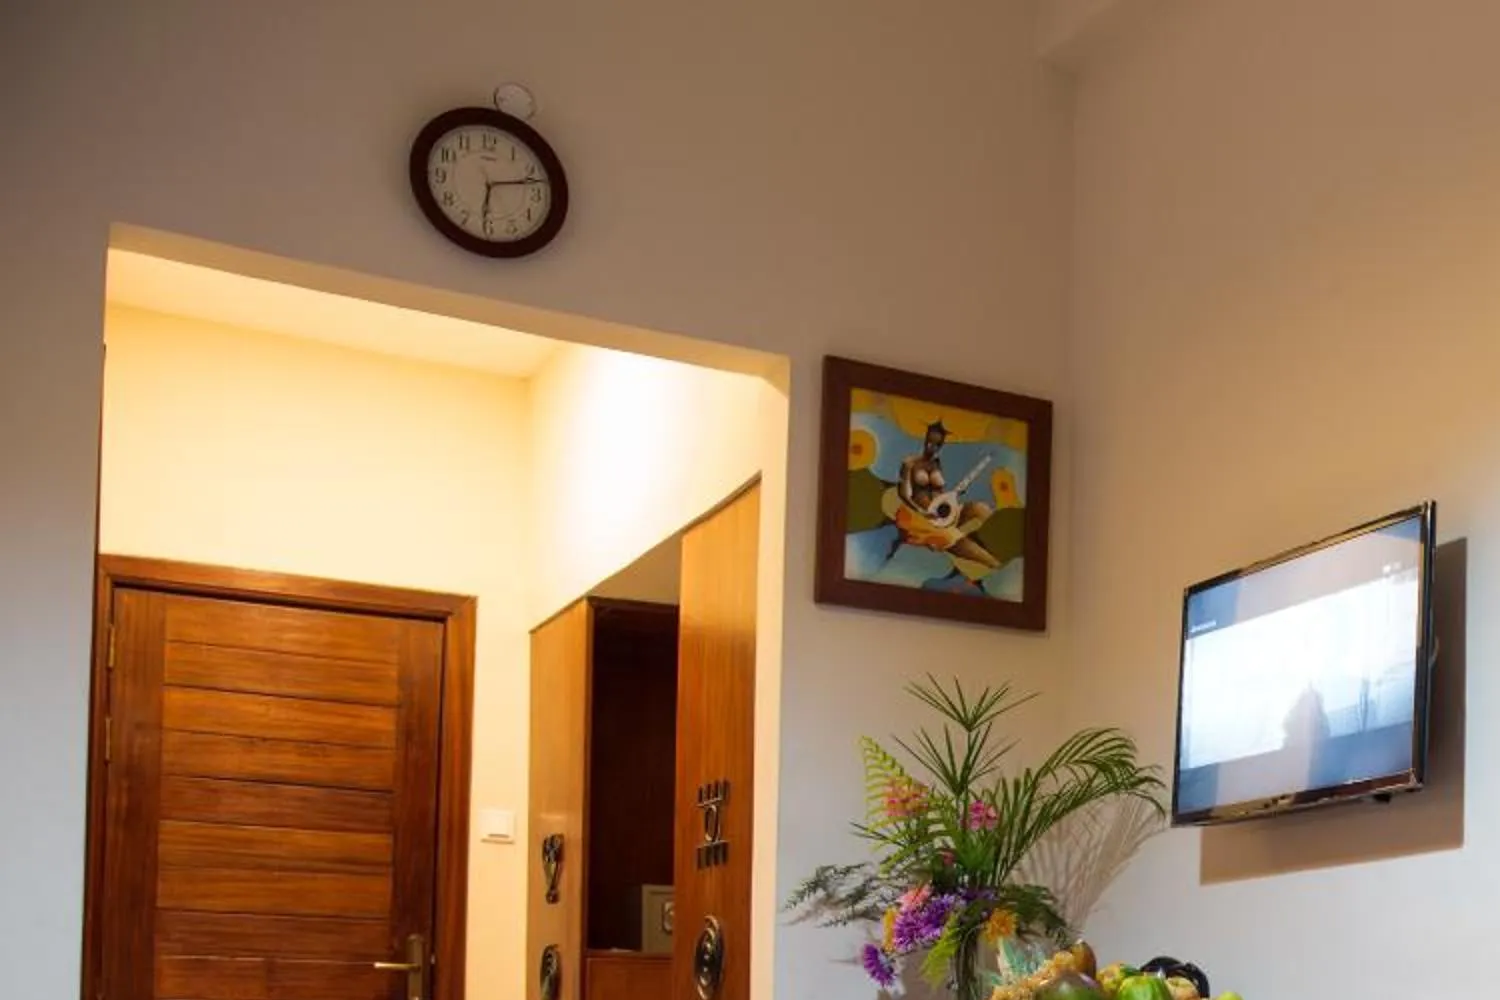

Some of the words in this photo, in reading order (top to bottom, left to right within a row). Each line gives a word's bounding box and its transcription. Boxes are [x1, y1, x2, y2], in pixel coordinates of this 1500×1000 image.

[458, 133, 470, 151] 11
[482, 133, 497, 152] 12
[441, 147, 457, 163] 10
[510, 145, 516, 162] 1
[435, 167, 447, 184] 9
[443, 191, 454, 206] 8
[529, 187, 542, 203] 3
[461, 208, 470, 226] 7
[482, 219, 494, 236] 6
[505, 218, 518, 235] 5
